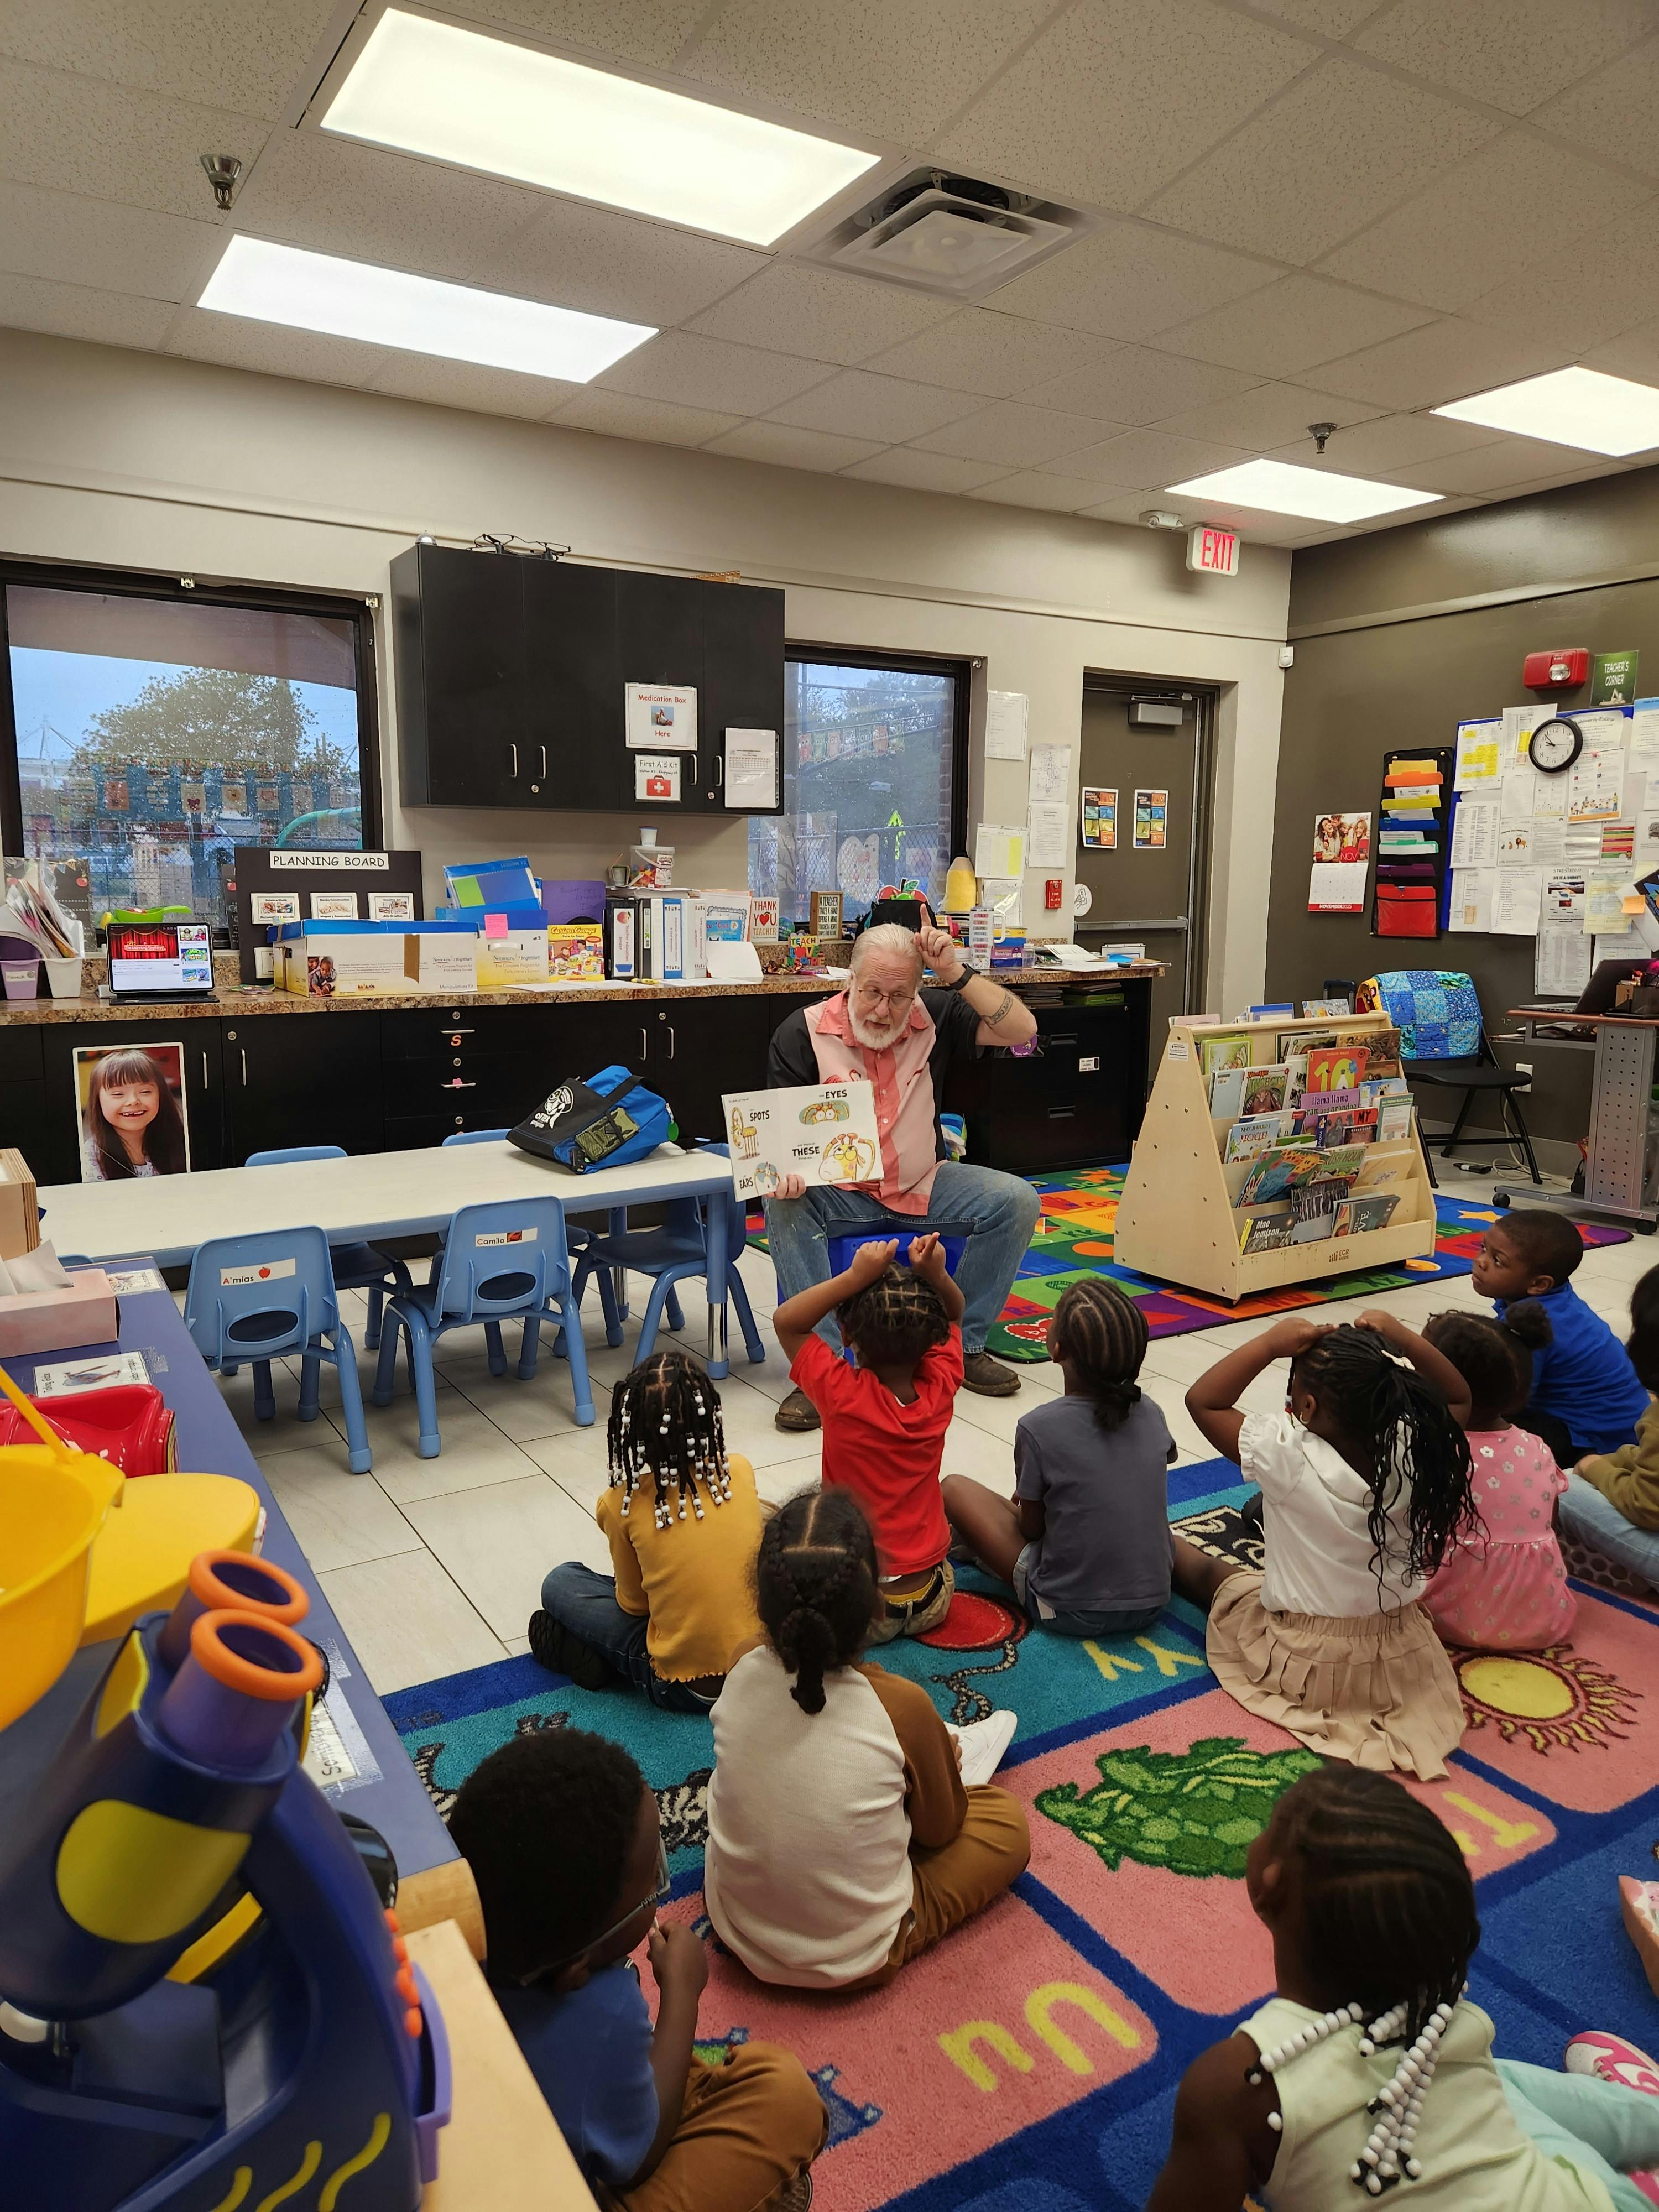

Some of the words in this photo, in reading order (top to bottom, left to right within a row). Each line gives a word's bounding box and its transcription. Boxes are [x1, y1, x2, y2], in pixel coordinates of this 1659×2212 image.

[1201, 530, 1235, 571] EXIT
[1604, 661, 1629, 673] TEACHER'S
[1605, 674, 1624, 686] CORNER
[638, 694, 672, 703] Medication
[273, 855, 339, 866] PLANNING
[345, 857, 385, 867] BOARD
[1340, 852, 1358, 860] NOV
[754, 901, 777, 911] THANK
[820, 896, 822, 906] A
[823, 896, 838, 906] TEACHER
[551, 926, 574, 935] Curious
[574, 927, 596, 935] George
[791, 937, 816, 946] TEACH
[1314, 1058, 1355, 1092] 10
[825, 1089, 847, 1099] EYES
[1312, 1096, 1329, 1105] llama
[1332, 1094, 1348, 1104] llama
[749, 1110, 770, 1122] SPOTS
[1357, 1110, 1371, 1124] MY
[792, 1146, 820, 1156] THESE
[1345, 1150, 1365, 1162] HOUR
[739, 1177, 753, 1190] EARS
[1256, 1220, 1270, 1229] Mae
[1254, 1228, 1280, 1239] Jemison
[223, 1276, 254, 1284] A'mias
